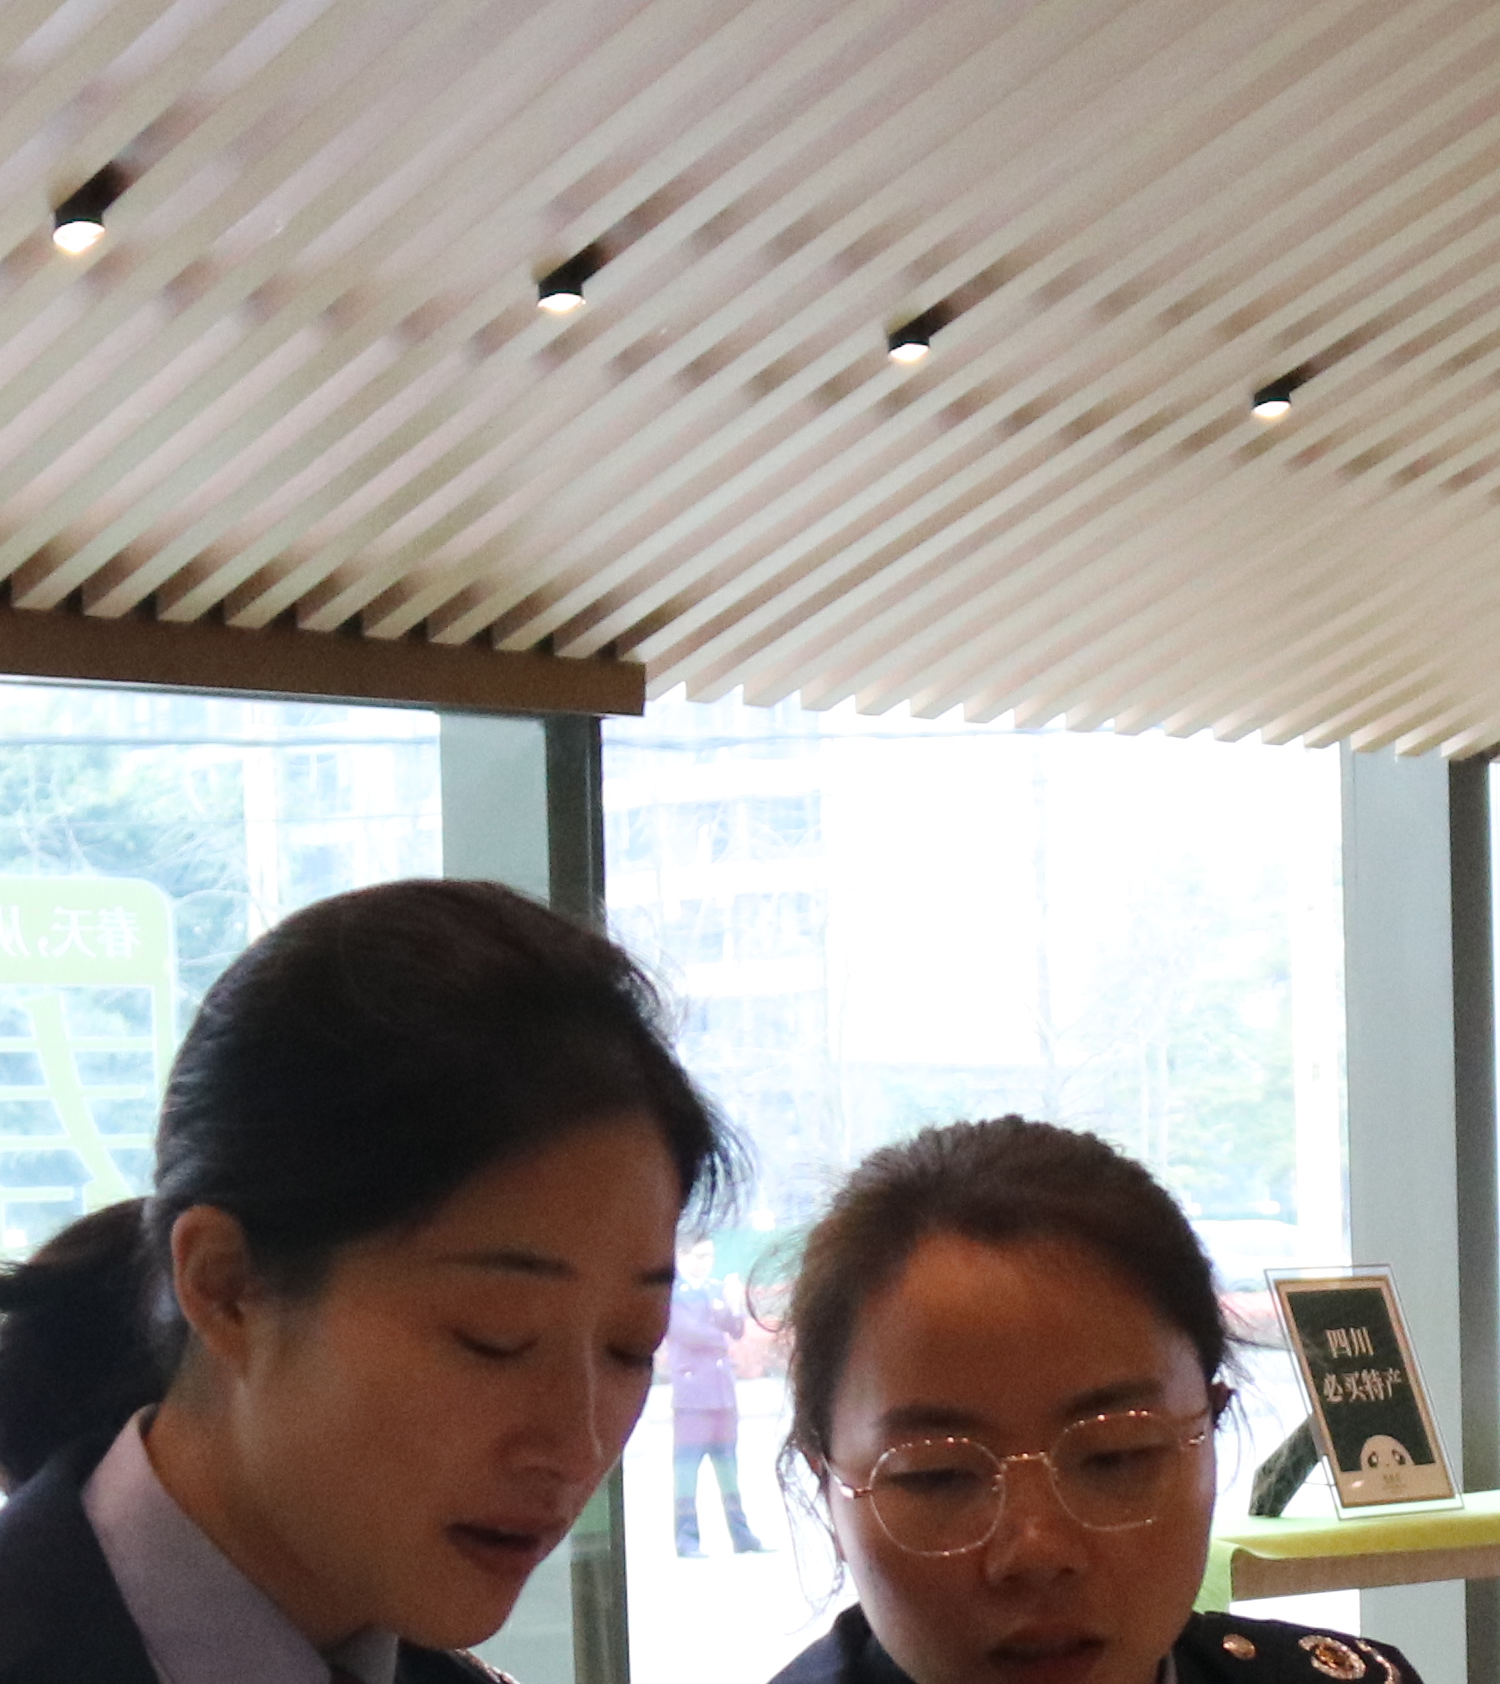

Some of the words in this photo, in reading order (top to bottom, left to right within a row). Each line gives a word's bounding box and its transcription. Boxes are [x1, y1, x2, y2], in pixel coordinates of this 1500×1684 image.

[1326, 1327, 1374, 1358] 四川
[1324, 1368, 1402, 1402] 必买特产
